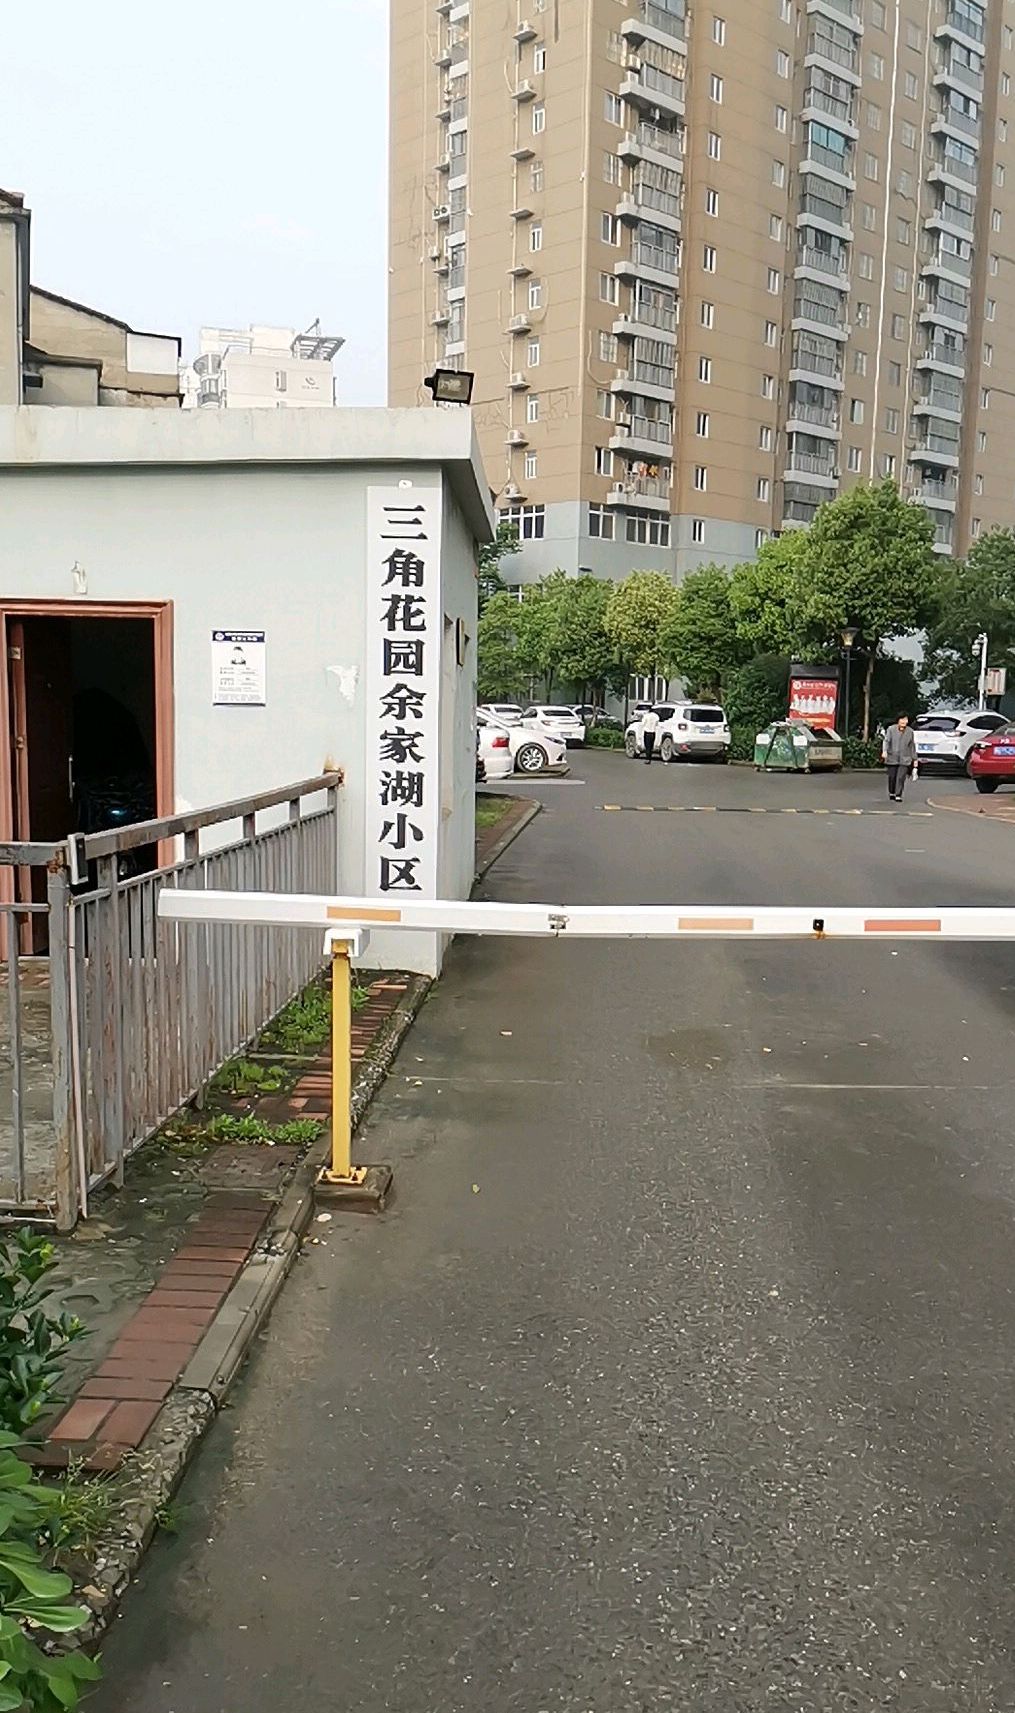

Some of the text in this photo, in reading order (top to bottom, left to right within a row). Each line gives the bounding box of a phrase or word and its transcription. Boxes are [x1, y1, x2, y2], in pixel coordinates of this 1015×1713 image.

[378, 505, 428, 892] 三角花园余家湖小区
